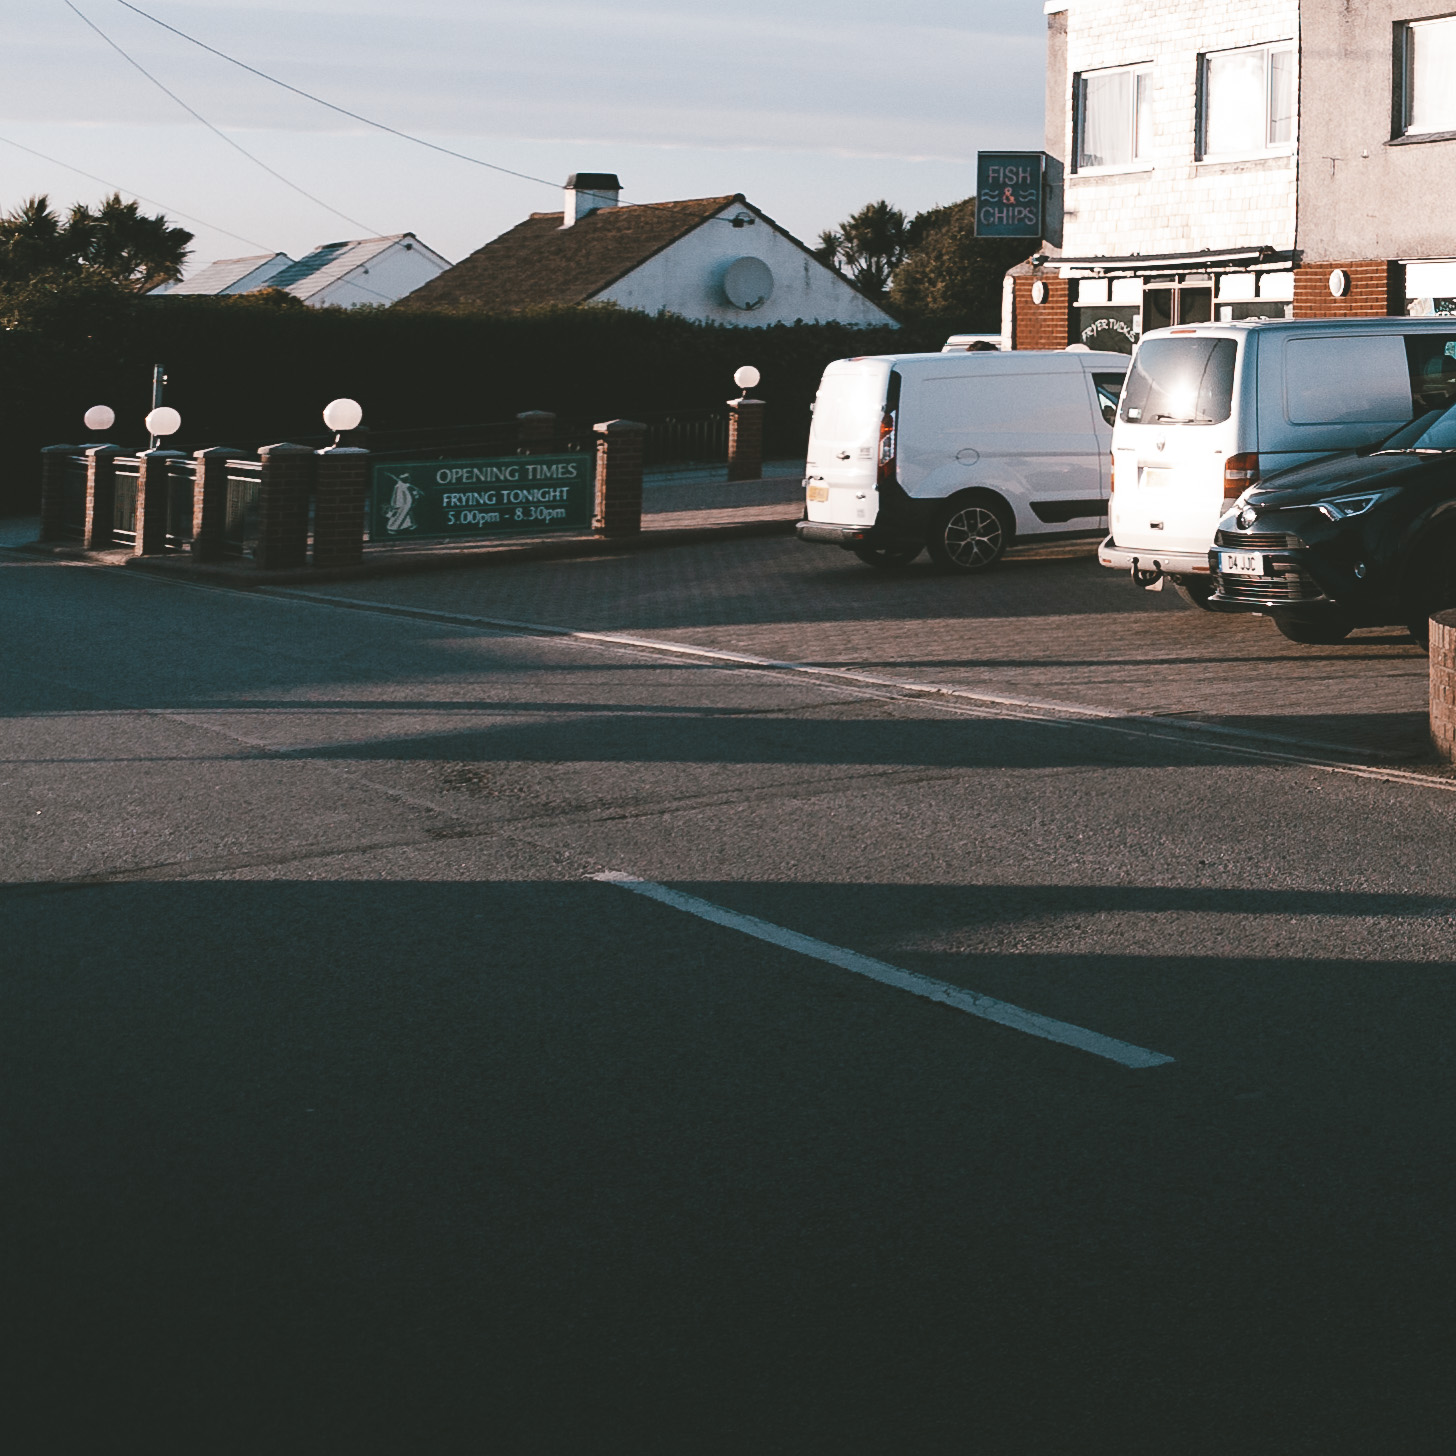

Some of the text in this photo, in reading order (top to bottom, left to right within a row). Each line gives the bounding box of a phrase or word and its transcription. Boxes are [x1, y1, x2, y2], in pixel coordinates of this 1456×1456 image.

[988, 166, 1031, 184] FISH
[1002, 187, 1016, 204] &
[980, 207, 1037, 225] CHIPS
[1081, 318, 1136, 343] FRYER TUCKS
[436, 463, 577, 484] OPENING TIMES
[442, 487, 570, 507] FRYING TONIGHT
[447, 510, 500, 527] 5.00pm
[514, 507, 566, 524] 8.30pm
